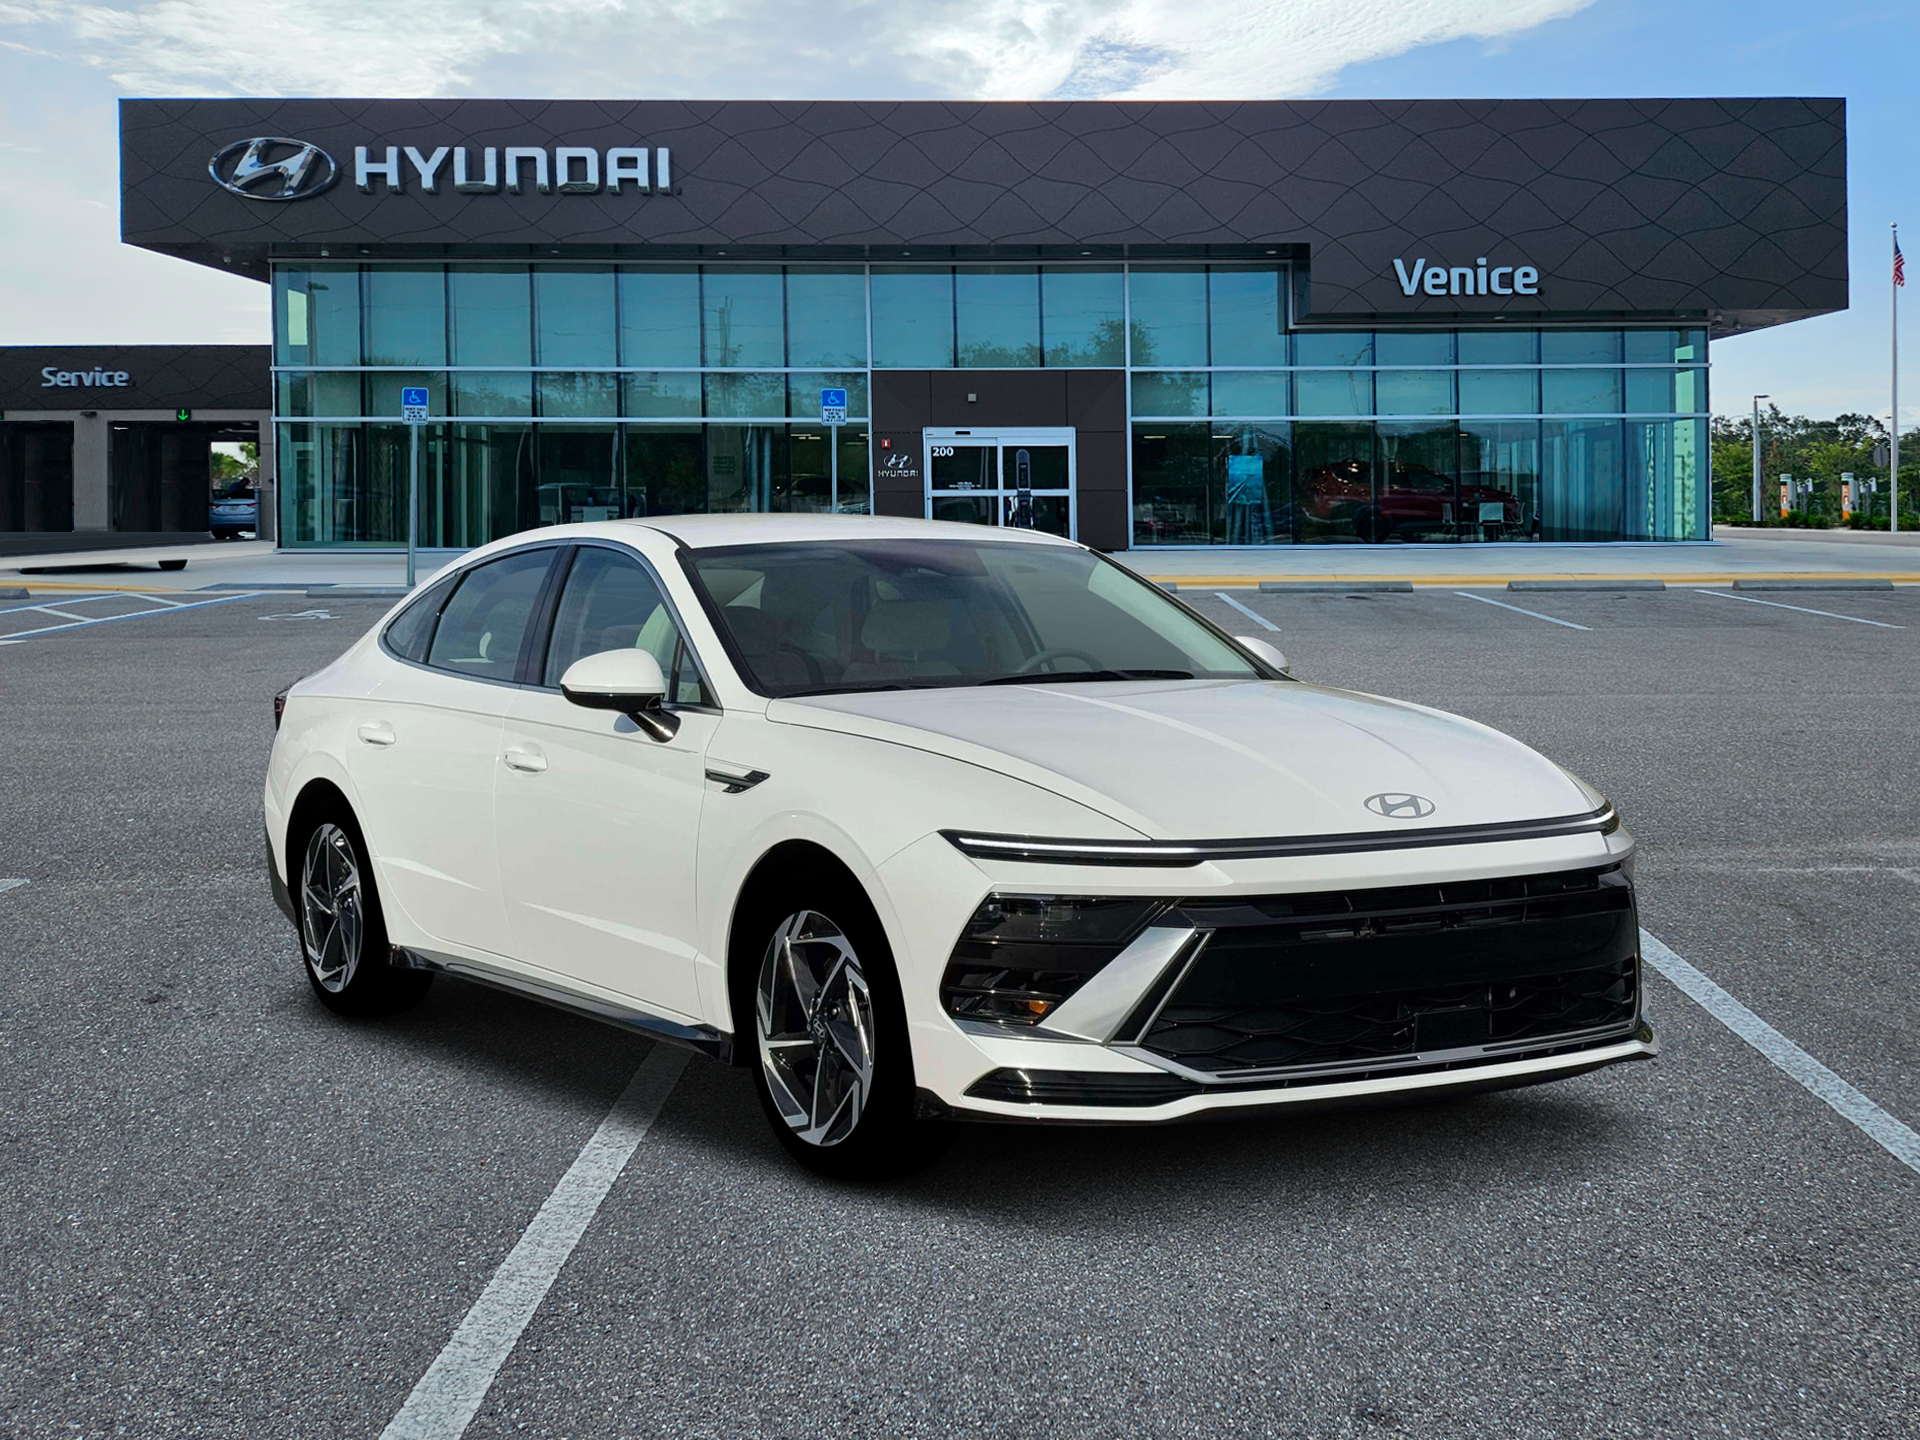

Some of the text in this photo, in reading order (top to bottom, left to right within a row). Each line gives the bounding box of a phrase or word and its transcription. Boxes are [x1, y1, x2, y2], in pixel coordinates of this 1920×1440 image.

[354, 146, 671, 193] HYUNDAI
[1393, 257, 1539, 296] Venice
[41, 366, 130, 387] Service
[932, 446, 954, 457] 200
[877, 469, 919, 478] HYUNDAI
